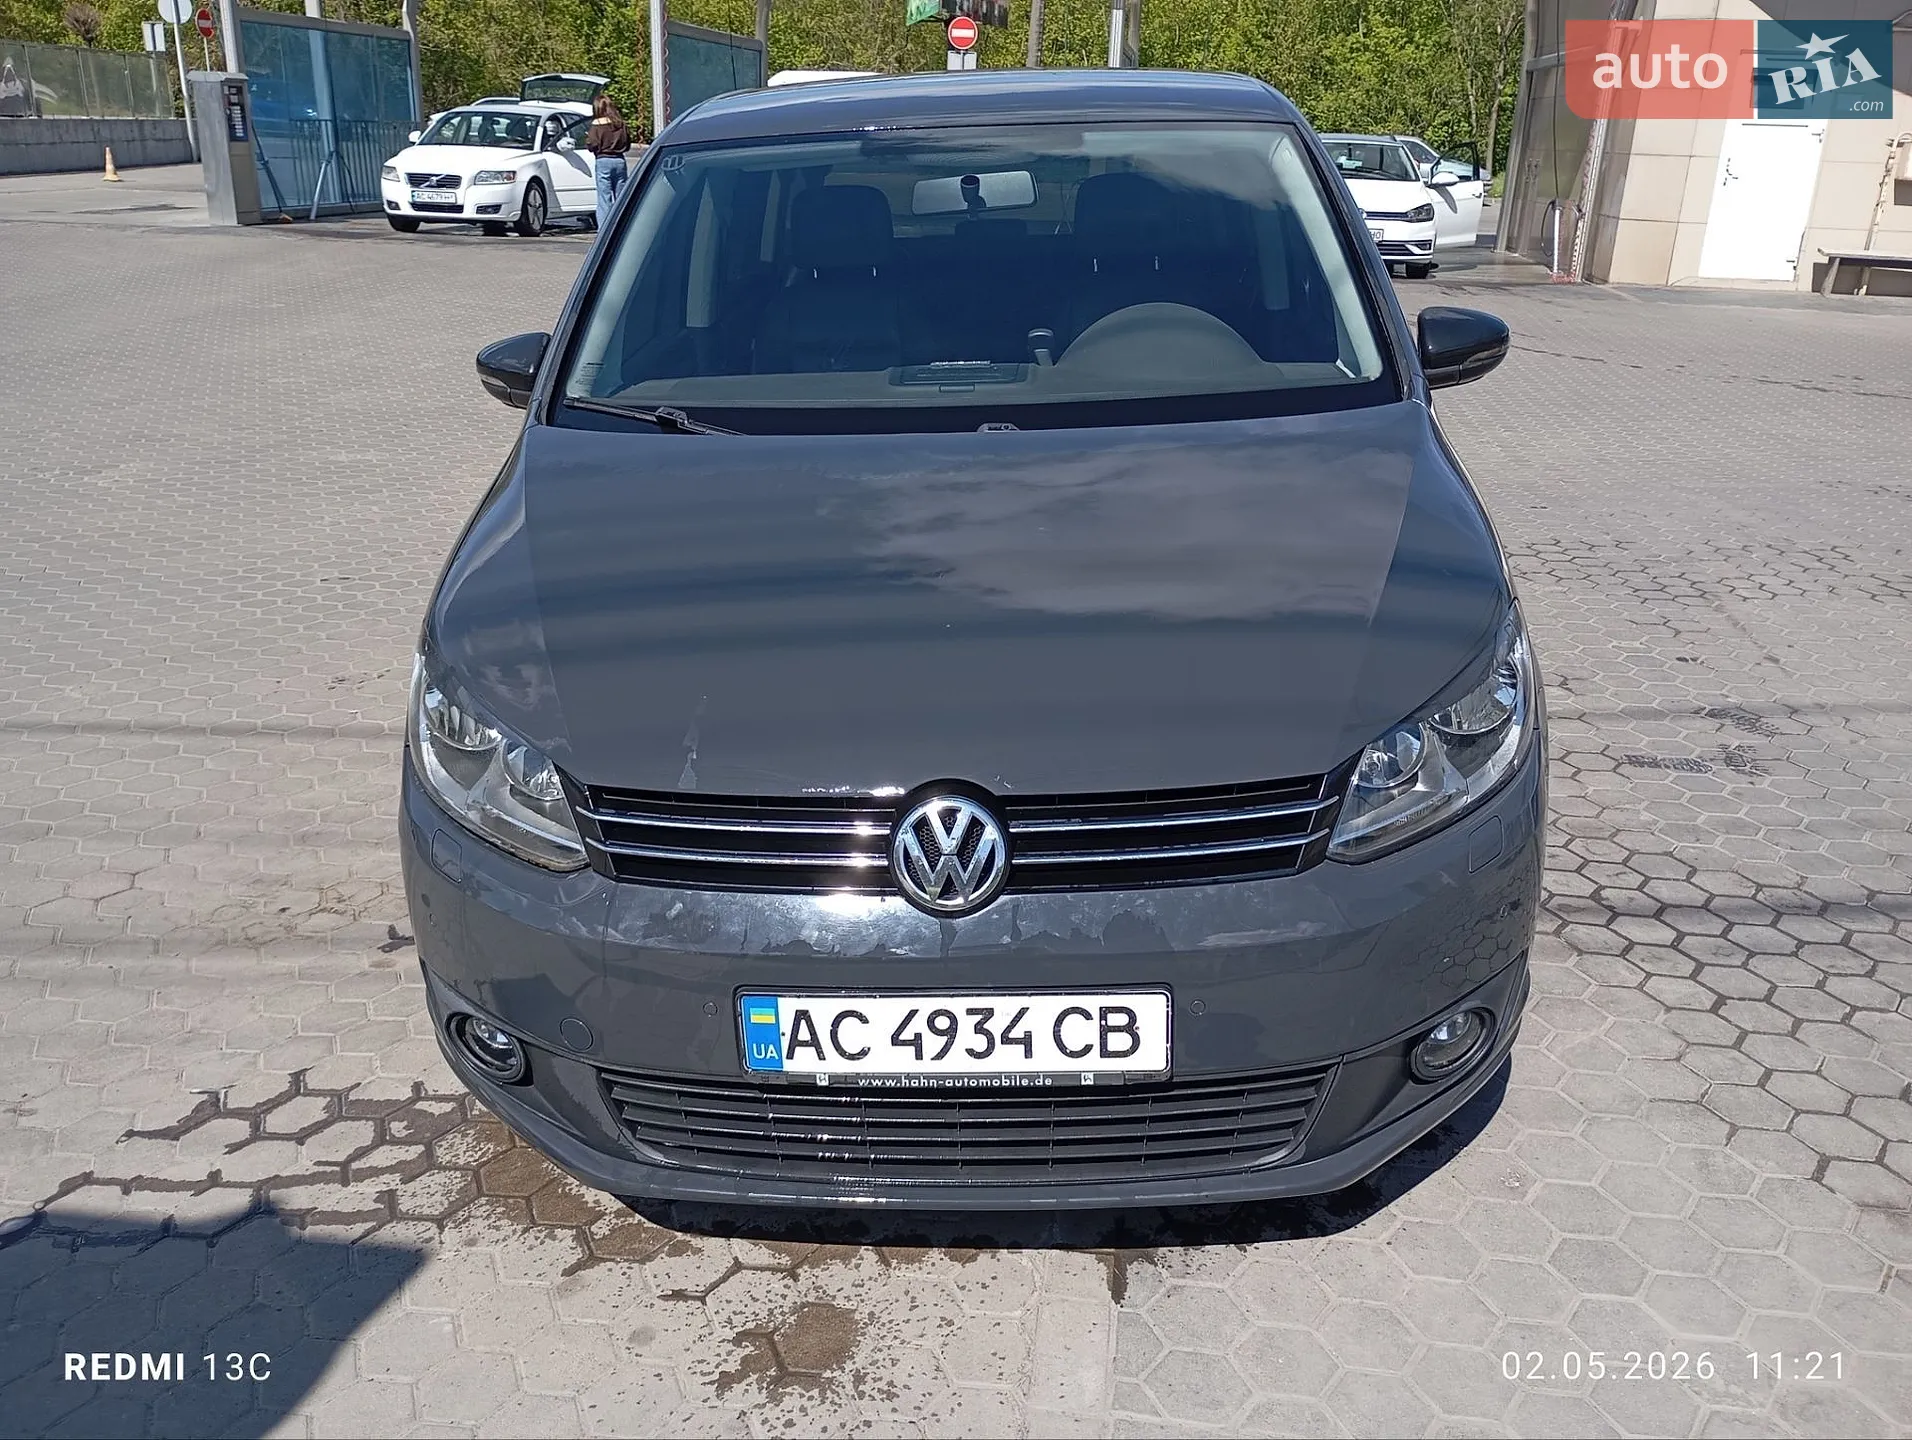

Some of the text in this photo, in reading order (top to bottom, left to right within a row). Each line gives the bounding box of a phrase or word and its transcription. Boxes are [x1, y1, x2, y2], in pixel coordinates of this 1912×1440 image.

[785, 1006, 1141, 1061] AC 4934 CB
[753, 1043, 779, 1060] UA
[858, 1074, 1053, 1088] www.hahn-automobile.de
